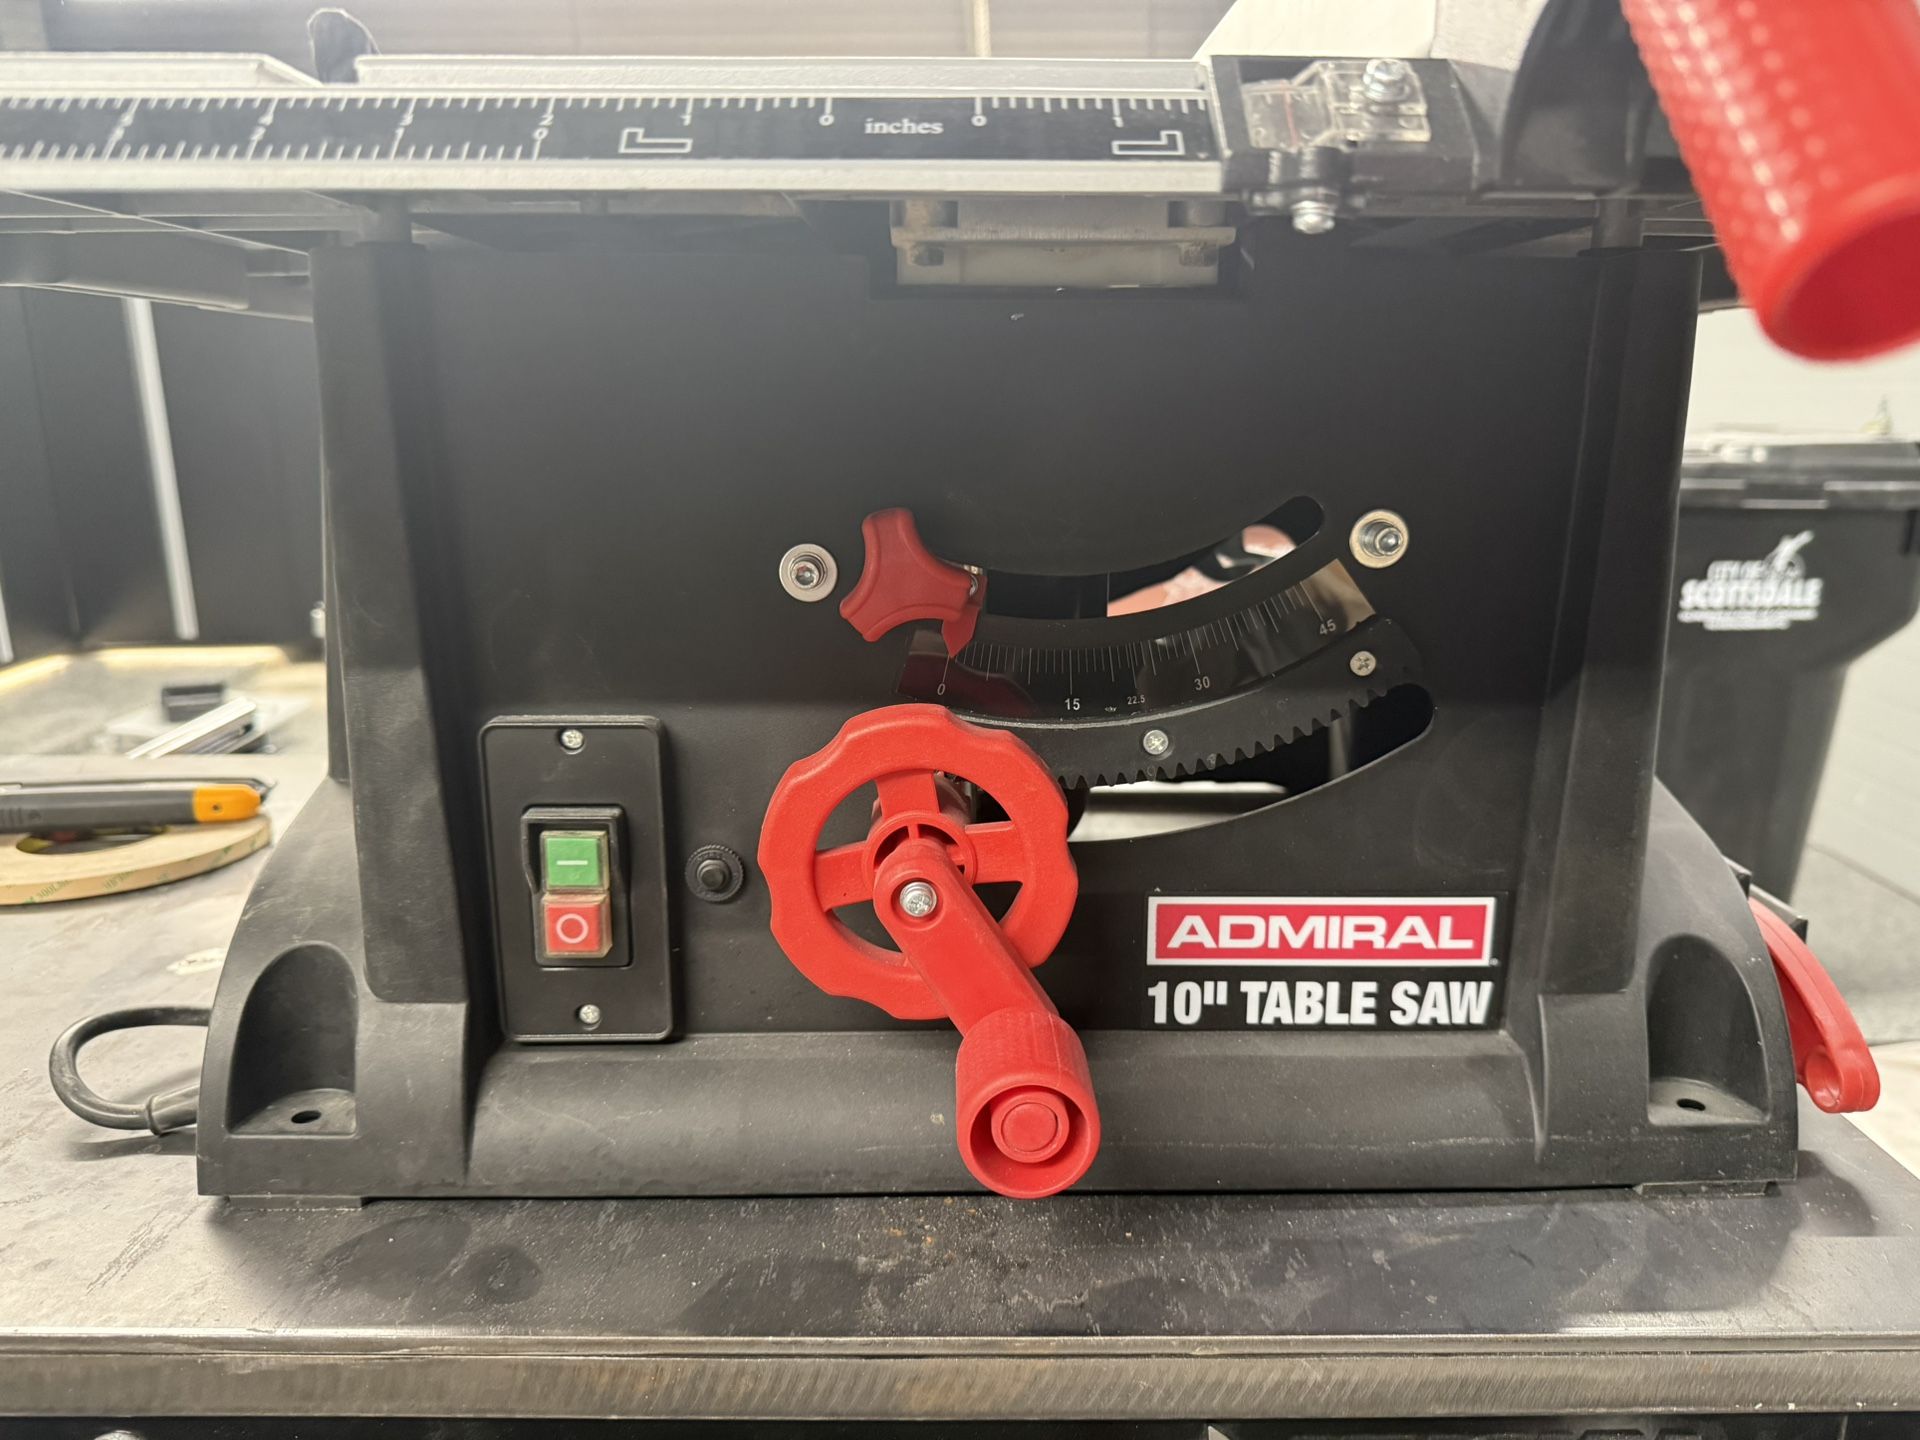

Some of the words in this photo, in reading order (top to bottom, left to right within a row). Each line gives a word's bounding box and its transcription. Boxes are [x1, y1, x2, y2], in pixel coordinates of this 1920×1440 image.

[399, 113, 414, 126] 3
[538, 113, 554, 126] 2
[818, 114, 835, 127] 0
[863, 117, 944, 135] inches
[970, 114, 988, 128] 0
[532, 127, 549, 141] 0
[1319, 619, 1337, 636] 45
[936, 683, 946, 696] 0
[1194, 676, 1210, 691] 30
[1064, 698, 1081, 711] 15
[1126, 694, 1146, 705] 22.5
[1167, 914, 1475, 950] ADMIRAL
[1147, 980, 1229, 1025] 10"
[1240, 980, 1379, 1025] TABLE
[1389, 980, 1494, 1025] SAW
